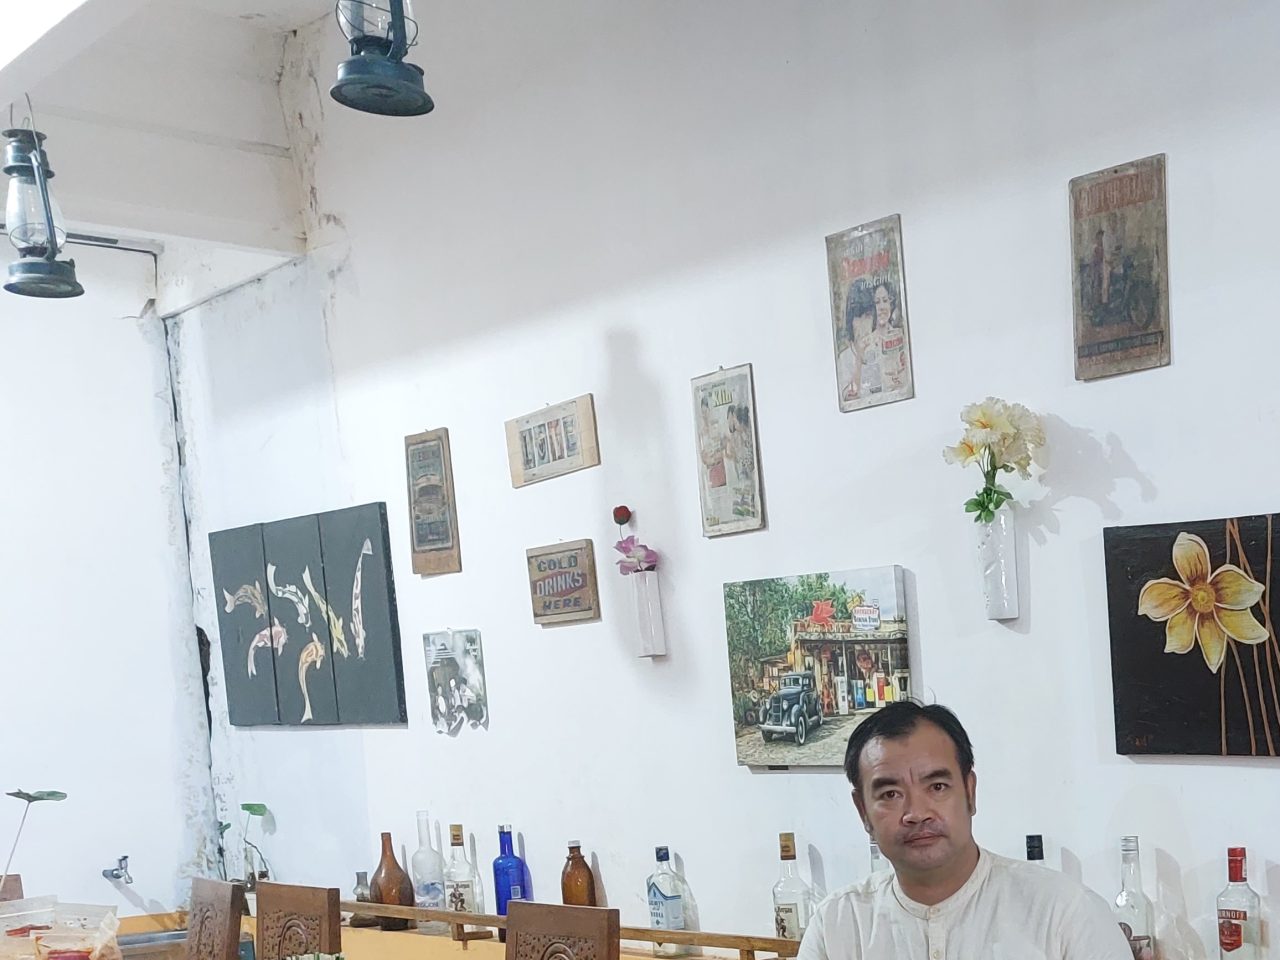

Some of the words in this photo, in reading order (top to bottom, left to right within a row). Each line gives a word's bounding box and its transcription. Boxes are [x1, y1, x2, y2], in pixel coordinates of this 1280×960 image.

[536, 553, 578, 572] COLD
[536, 570, 583, 597] DRINKS
[542, 596, 582, 610] HERE
